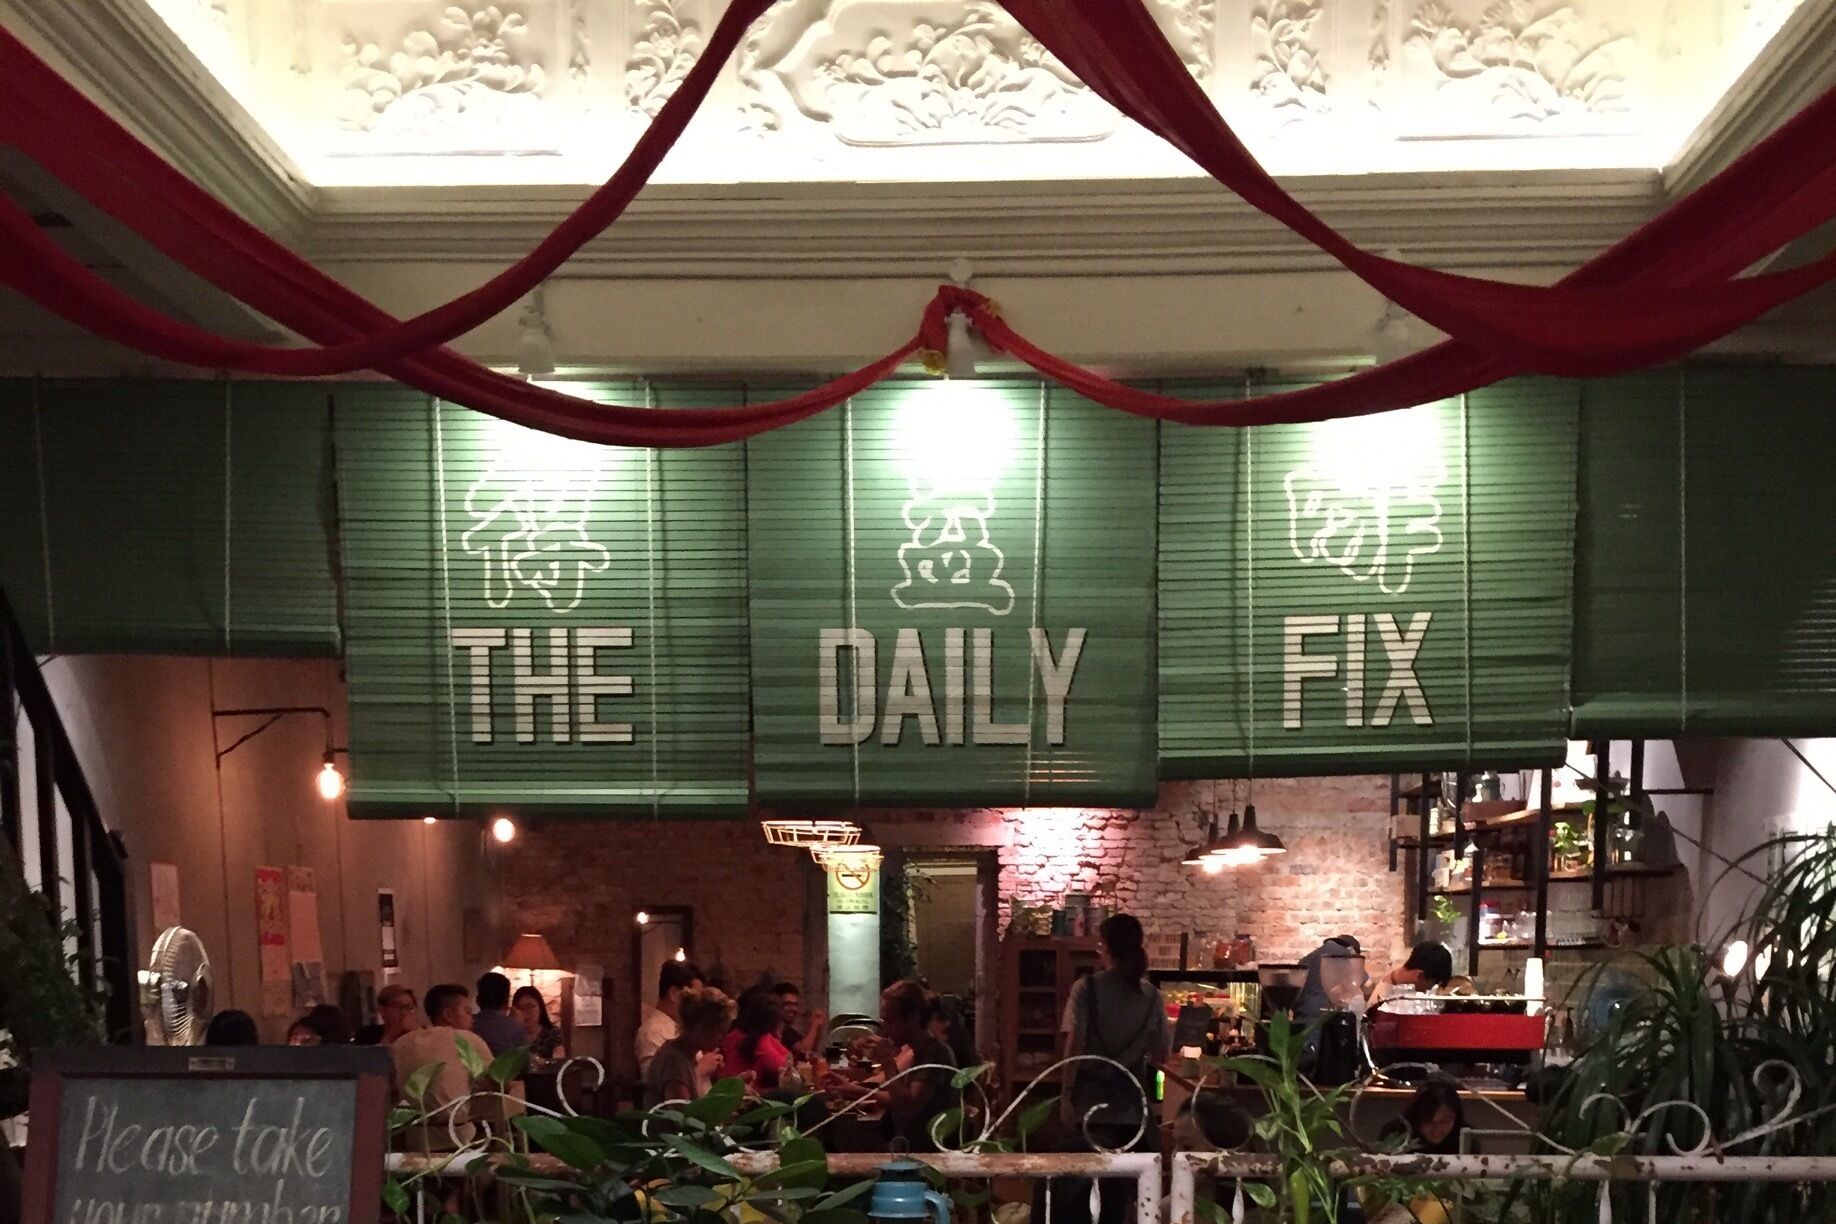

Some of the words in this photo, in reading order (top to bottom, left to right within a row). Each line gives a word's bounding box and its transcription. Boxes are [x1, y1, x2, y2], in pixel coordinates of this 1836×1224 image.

[449, 627, 636, 746] THE
[817, 627, 1088, 748] DAILY
[1281, 611, 1434, 731] FIX
[76, 1095, 217, 1174] Please
[232, 1095, 333, 1178] take
